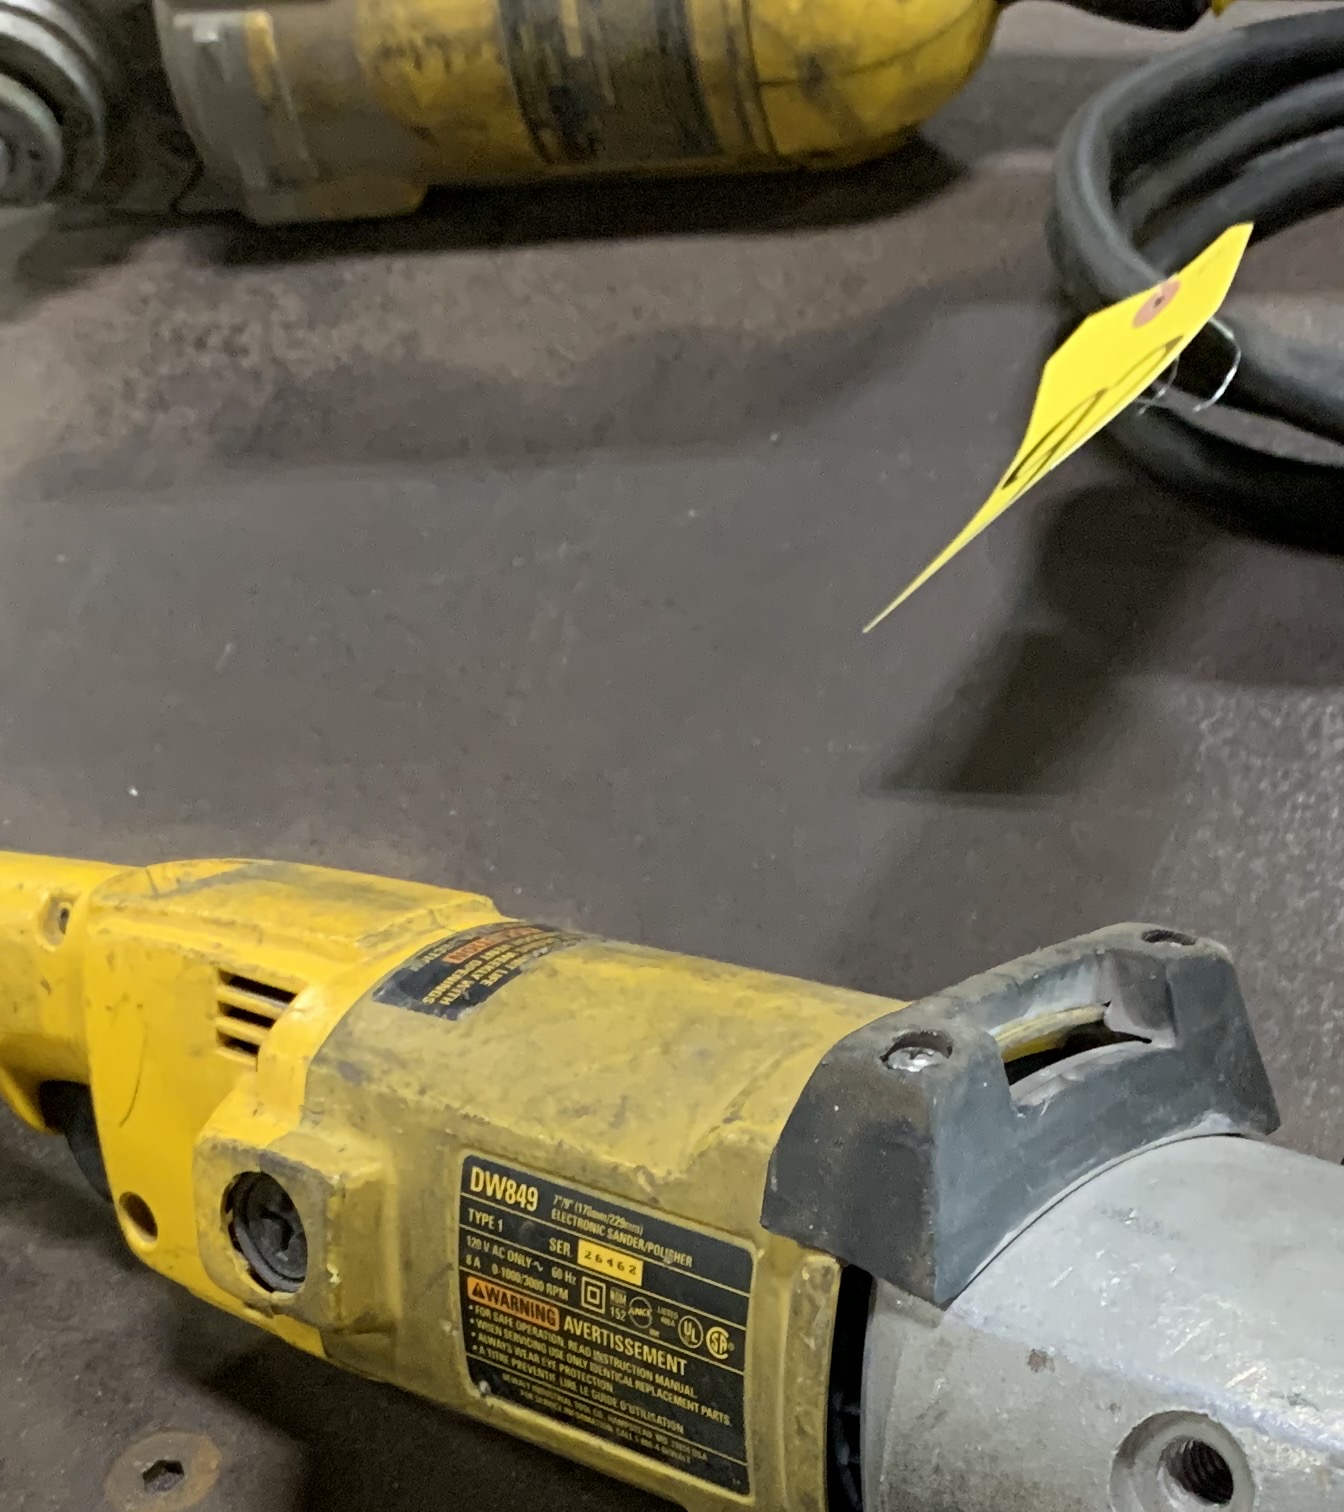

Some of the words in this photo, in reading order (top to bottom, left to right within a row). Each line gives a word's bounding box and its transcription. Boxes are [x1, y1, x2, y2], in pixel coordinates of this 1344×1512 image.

[469, 1164, 539, 1215] DW849
[467, 1206, 496, 1231] TYPE
[497, 1217, 503, 1233] 1
[550, 1206, 606, 1238] ELECTRONIC
[606, 1226, 693, 1269] SANDER/POLISHER
[484, 1283, 556, 1327] WARNING
[562, 1313, 687, 1377] AVERTISSEMENT
